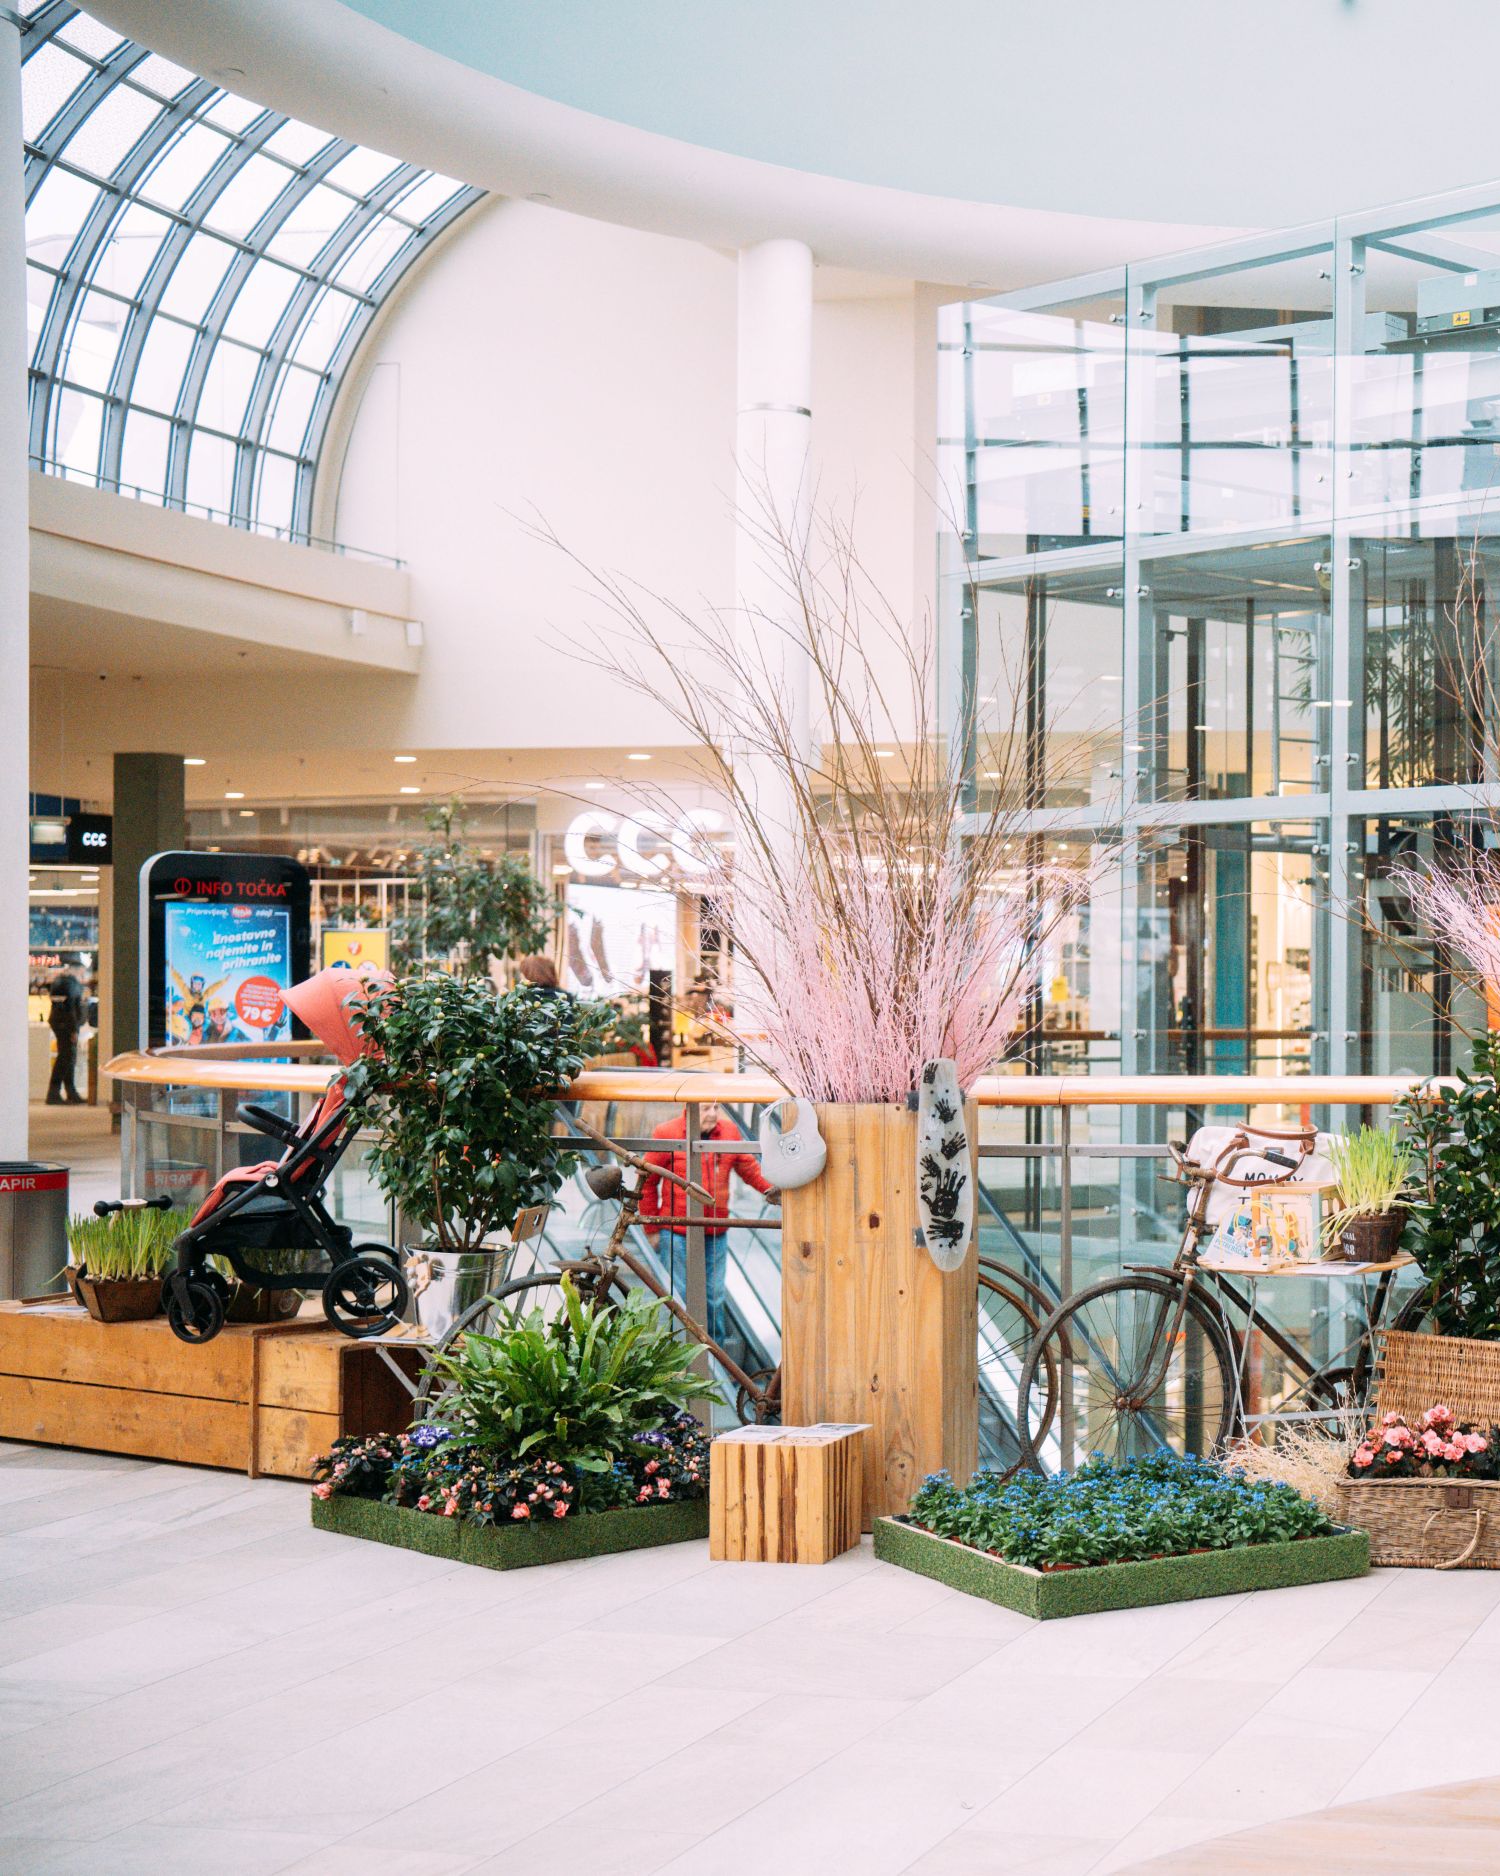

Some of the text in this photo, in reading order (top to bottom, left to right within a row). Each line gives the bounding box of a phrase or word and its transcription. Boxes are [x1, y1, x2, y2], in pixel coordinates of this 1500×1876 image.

[565, 810, 724, 876] CCC
[196, 878, 287, 896] INFO TOČKA
[206, 941, 273, 960] najemite in
[222, 953, 282, 972] prihranite
